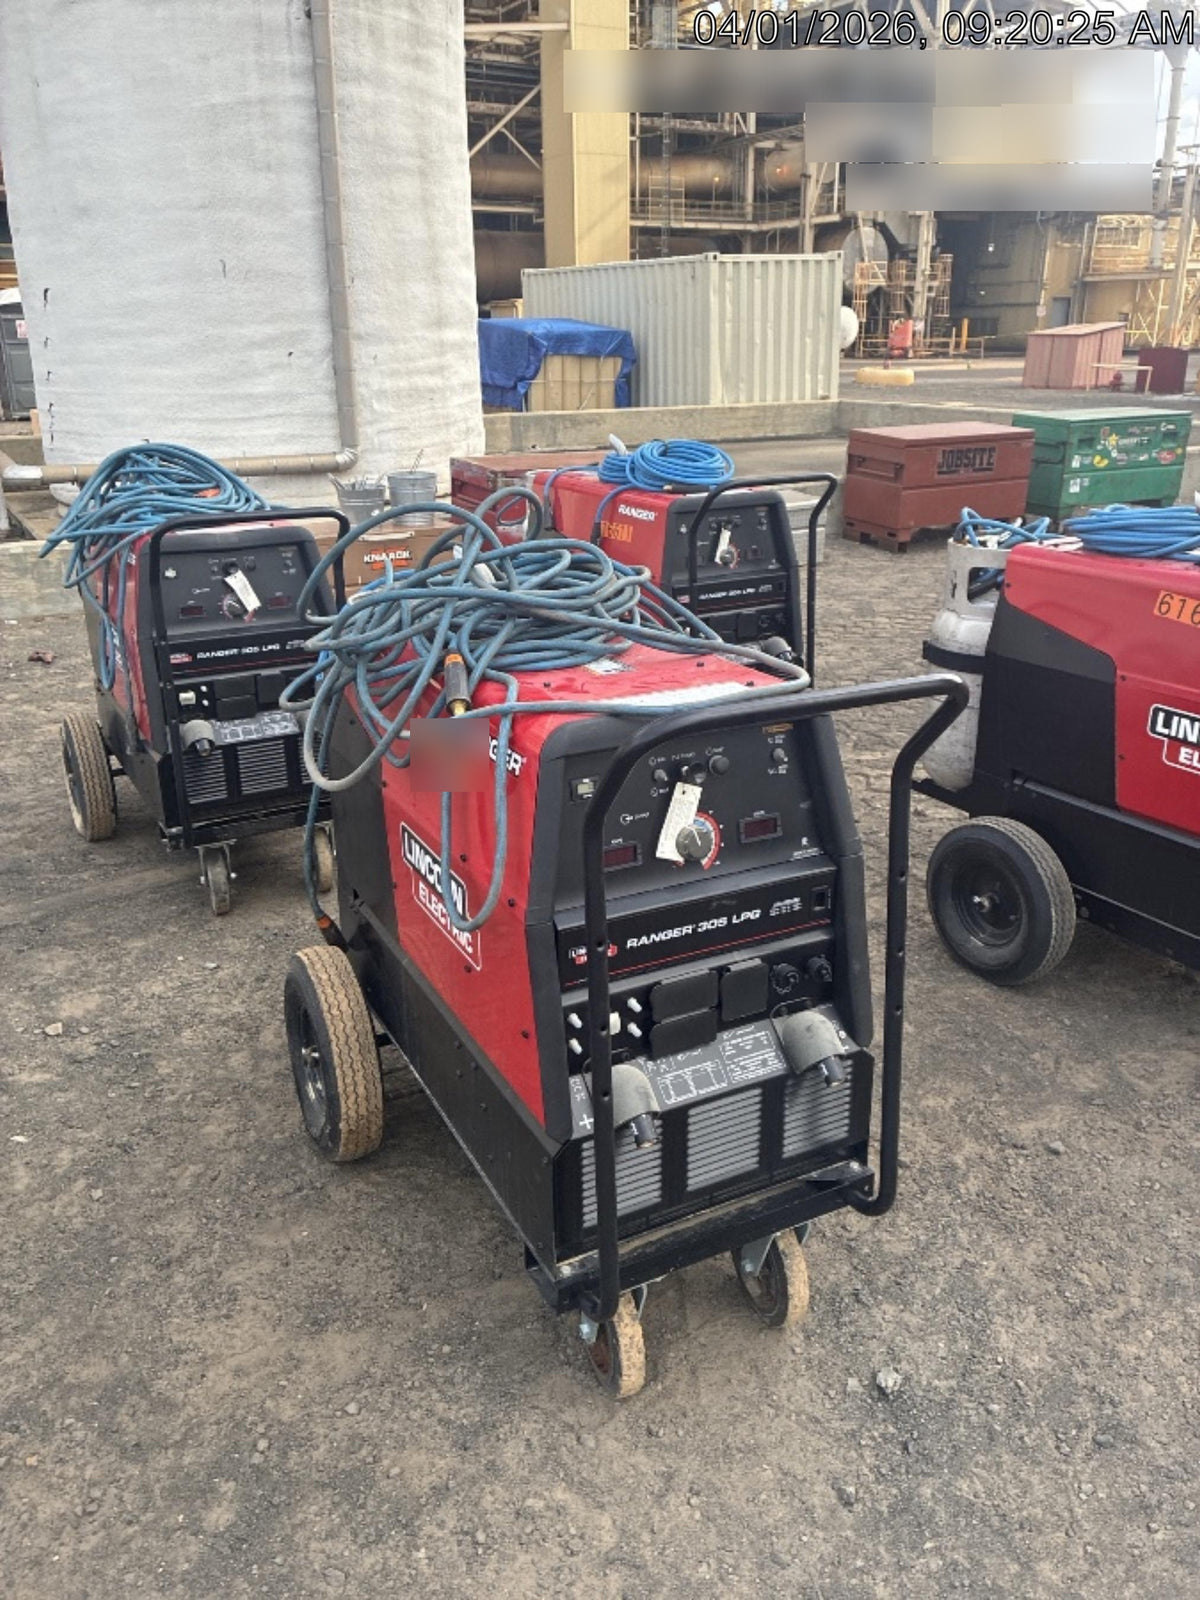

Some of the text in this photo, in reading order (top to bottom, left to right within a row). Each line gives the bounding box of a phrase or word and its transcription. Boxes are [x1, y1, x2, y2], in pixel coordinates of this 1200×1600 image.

[937, 446, 996, 472] JOBSITE
[618, 504, 656, 521] RANGER
[404, 831, 463, 916] LINCON
[626, 909, 762, 949] RANGER 305 LPG
